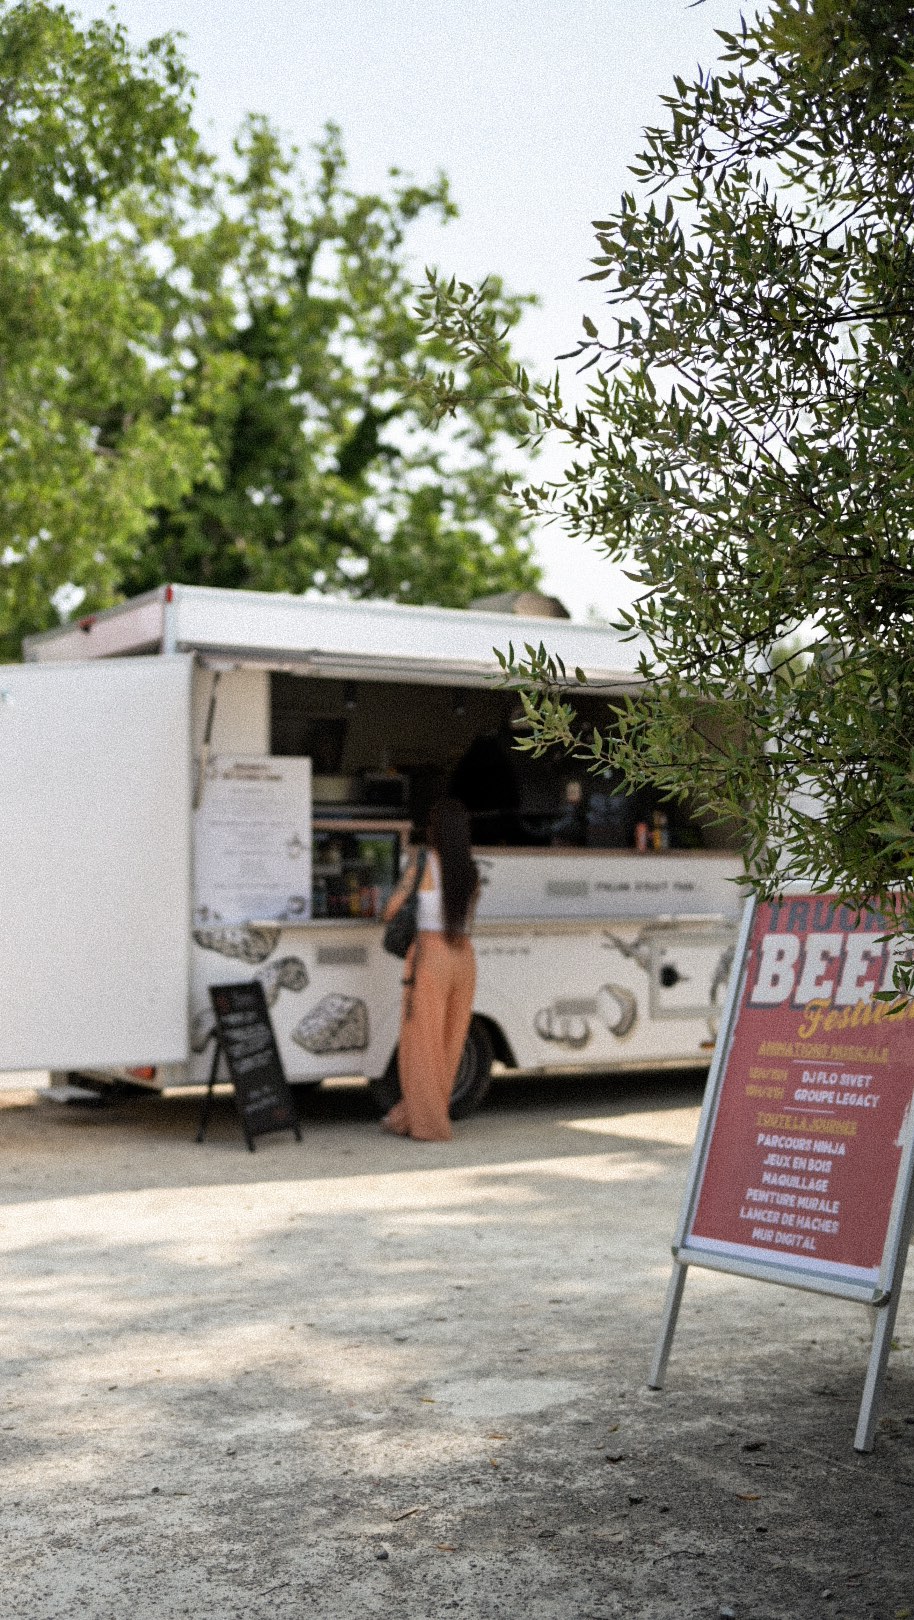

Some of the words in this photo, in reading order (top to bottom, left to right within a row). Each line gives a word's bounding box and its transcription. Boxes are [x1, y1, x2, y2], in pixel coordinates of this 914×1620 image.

[817, 1072, 838, 1086] FLO
[794, 1089, 835, 1104] GROUPE
[836, 1092, 880, 1108] LEGACY
[757, 1133, 812, 1151] PARCOURS
[813, 1140, 846, 1156] NINJA
[763, 1153, 791, 1168] JEUX
[793, 1157, 806, 1170] EN
[808, 1159, 832, 1173] BOIS
[762, 1171, 829, 1192] MAQUILLAGE
[746, 1187, 796, 1207] PEINTURE
[798, 1196, 840, 1214] MURALE
[739, 1207, 780, 1224] LANCER
[782, 1213, 795, 1226] DE
[796, 1217, 840, 1235] HACHES
[752, 1227, 774, 1242] MUR
[775, 1231, 816, 1250] DIGITAL
